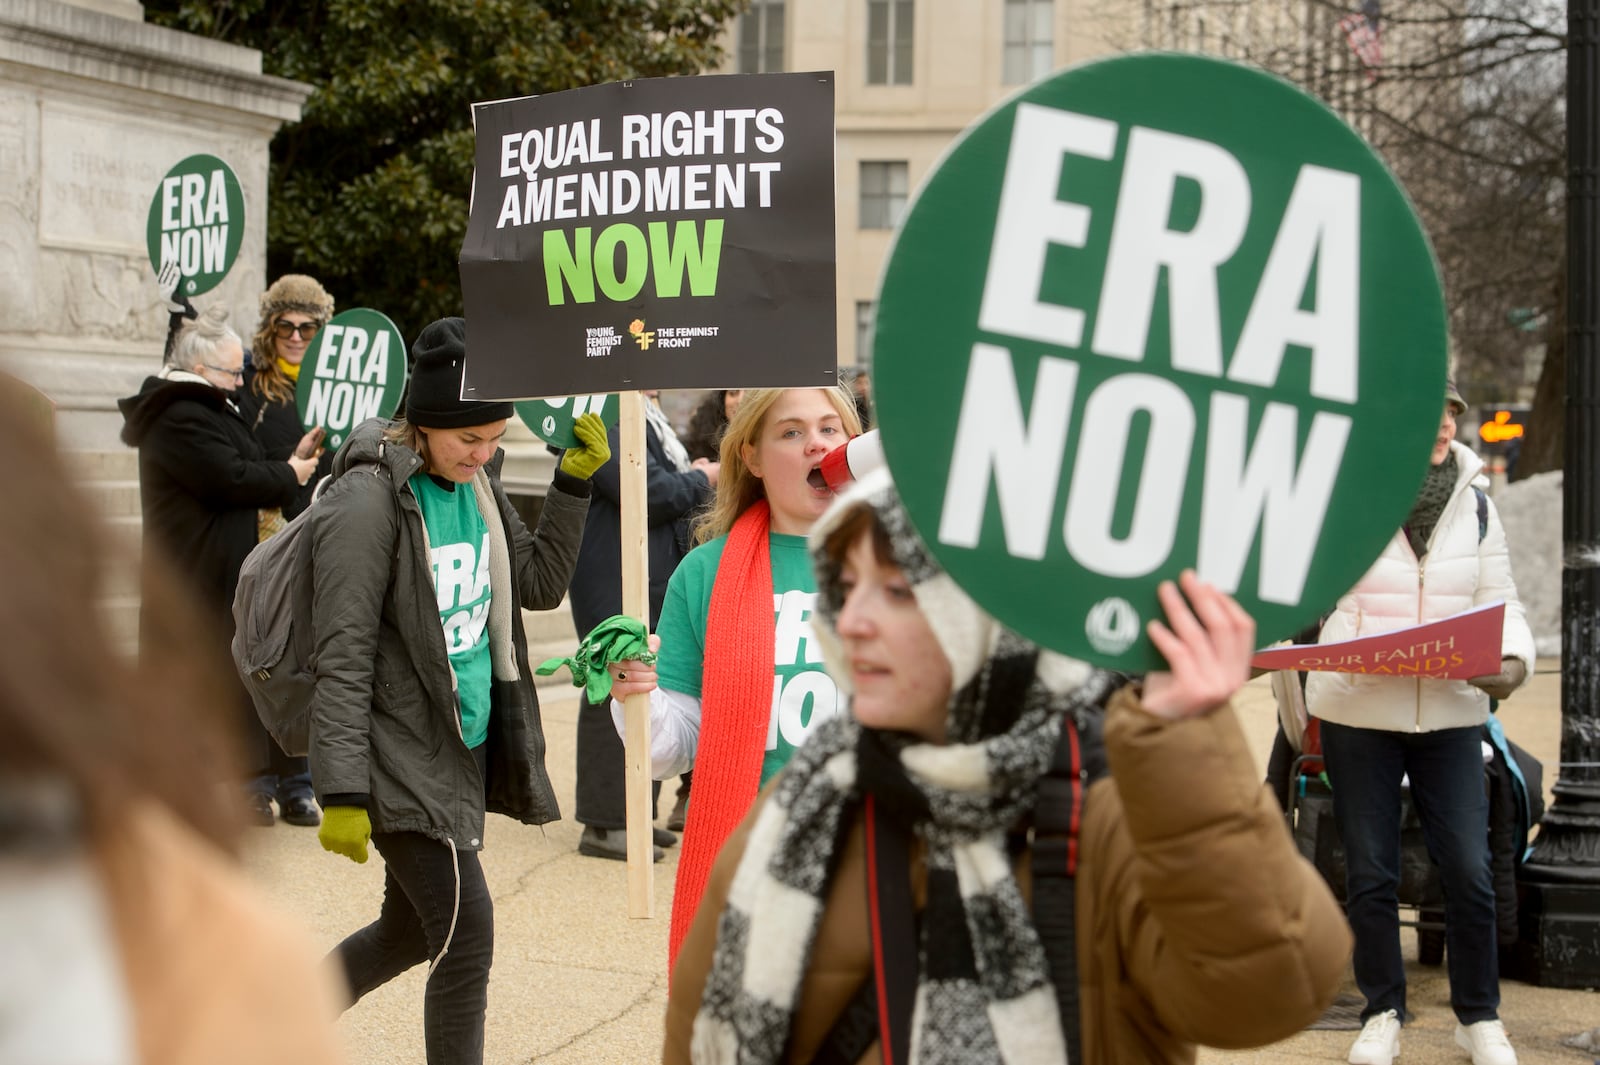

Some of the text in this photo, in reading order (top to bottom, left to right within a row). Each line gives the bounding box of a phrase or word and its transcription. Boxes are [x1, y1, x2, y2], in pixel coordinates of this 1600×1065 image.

[500, 108, 784, 181] EQUAL RIGHTS
[162, 169, 228, 231] ERA
[496, 162, 781, 229] AMENDMENT
[160, 224, 228, 276] NOW
[543, 219, 724, 306] NOW
[979, 103, 1360, 402] ERA
[315, 325, 390, 385] ERA
[586, 327, 614, 338] YOUNG
[586, 335, 622, 347] FEMINIST
[586, 346, 612, 357] PARTY
[657, 327, 719, 338] THE FEMINIST
[658, 338, 691, 348] FRONT
[304, 379, 384, 431] NOW
[939, 344, 1353, 607] NOW
[1299, 636, 1454, 666] OUR FAITH
